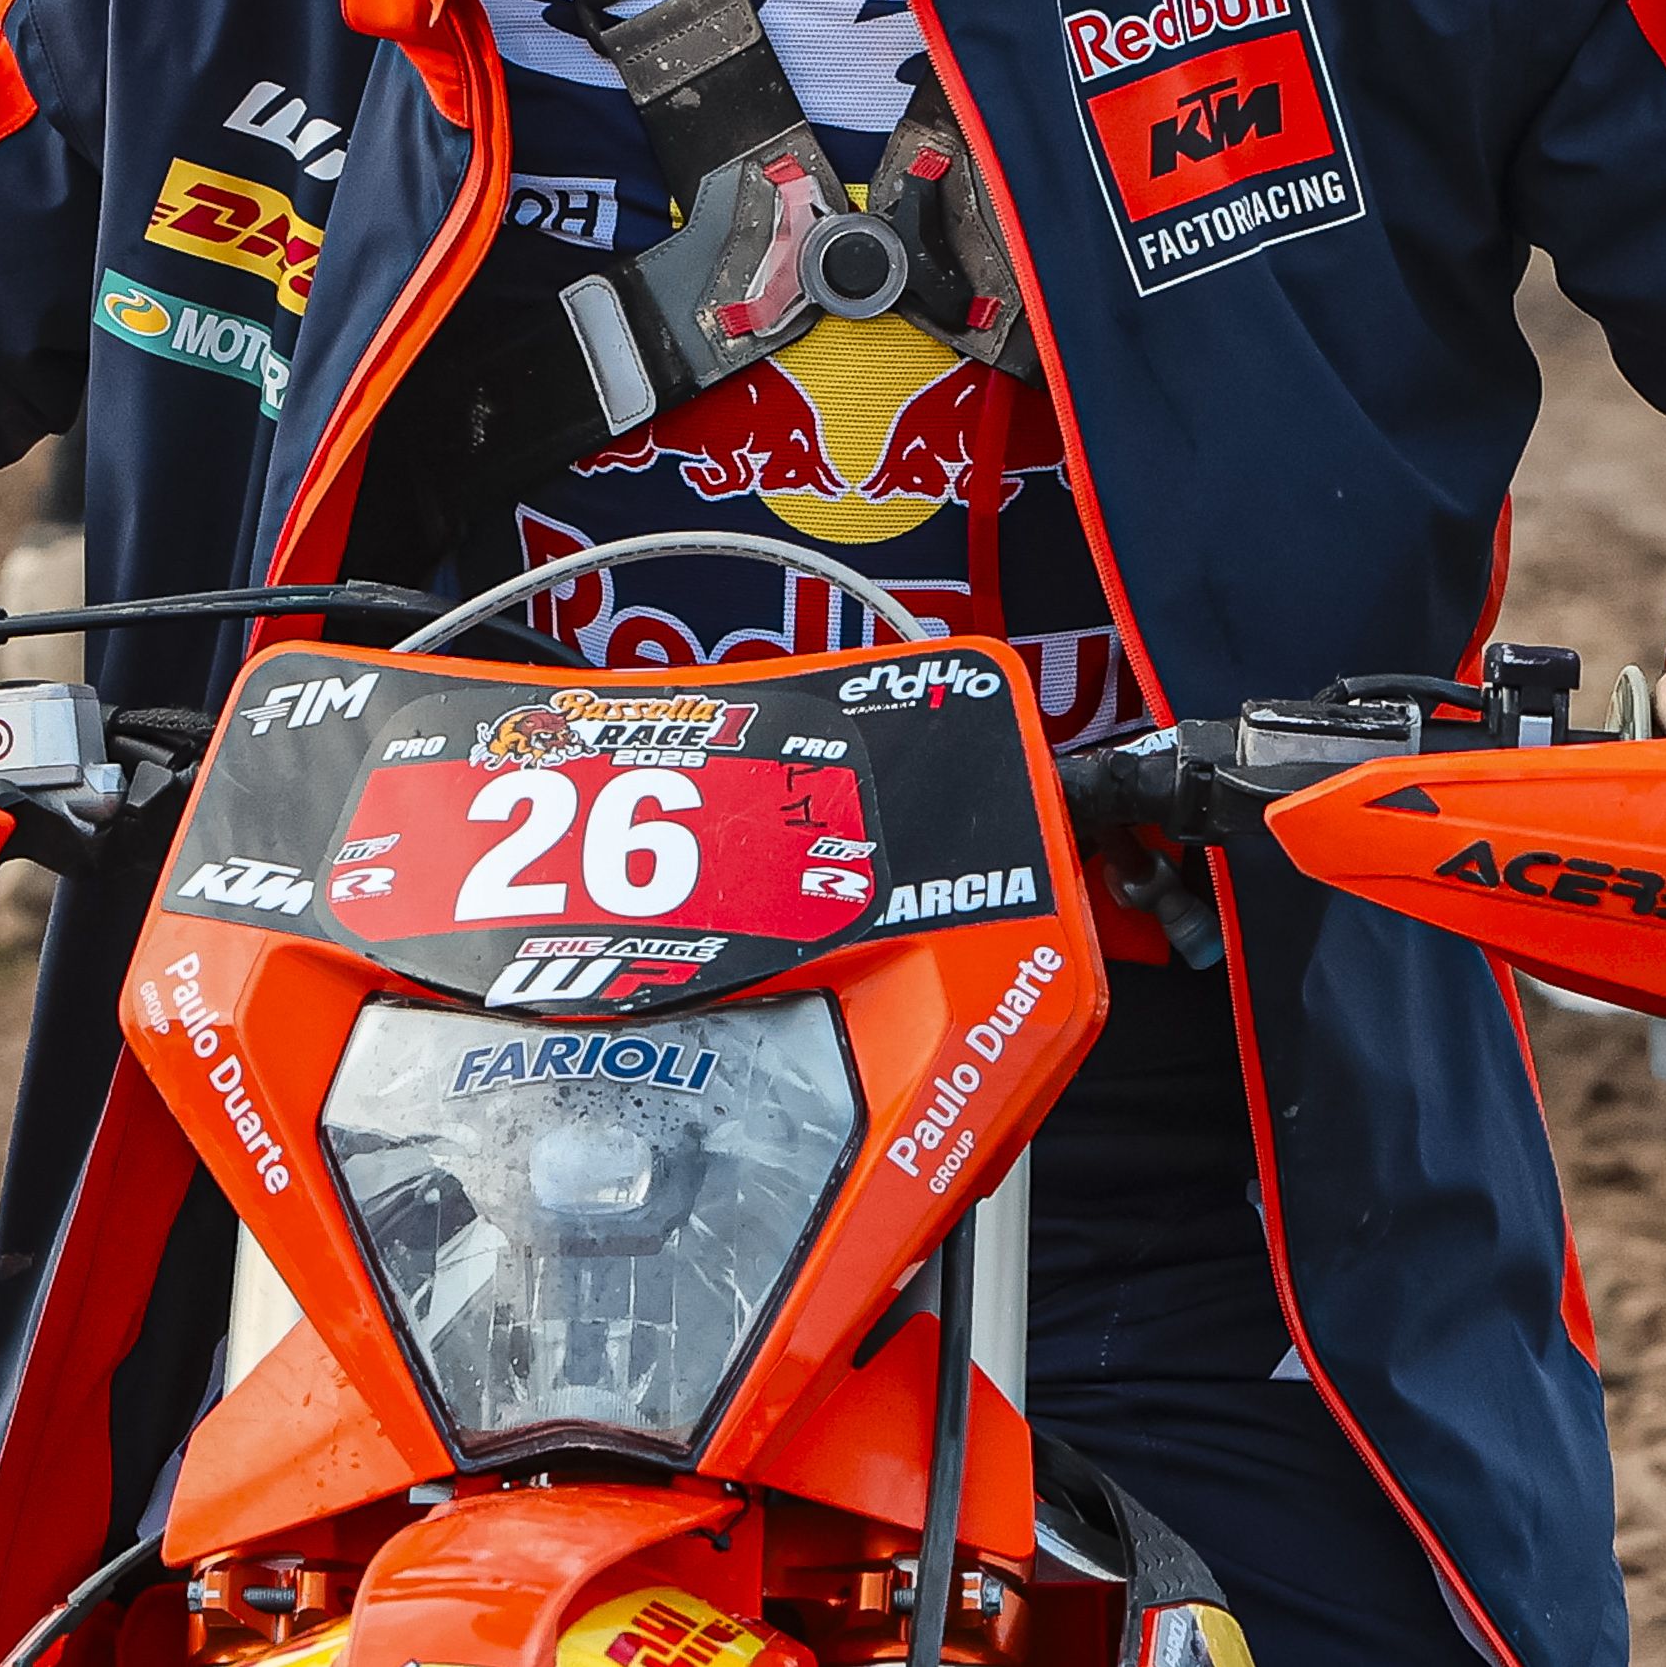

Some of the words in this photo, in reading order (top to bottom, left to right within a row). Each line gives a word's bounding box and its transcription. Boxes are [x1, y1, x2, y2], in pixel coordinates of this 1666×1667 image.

[1149, 79, 1282, 180] KTM
[1137, 197, 1254, 271] FACTOR
[240, 672, 380, 736] FIM
[838, 659, 1001, 703] enduro
[382, 736, 447, 761] PRO
[593, 723, 711, 747] RACE
[706, 705, 758, 749] 1
[781, 736, 848, 760] PRO
[611, 749, 707, 767] 2026
[453, 767, 704, 923] 26
[176, 856, 315, 916] KTM
[874, 866, 1037, 927] ARCIA
[517, 937, 613, 958] ERIC
[139, 980, 171, 1035] GROUP
[485, 958, 701, 1008] WP
[164, 951, 220, 1059] Paulo
[209, 1053, 290, 1195] Duarte
[445, 1033, 720, 1096] FARIOLI
[886, 1063, 981, 1178] Paulo
[965, 945, 1063, 1064] Duarte
[928, 1129, 975, 1194] GROUP
